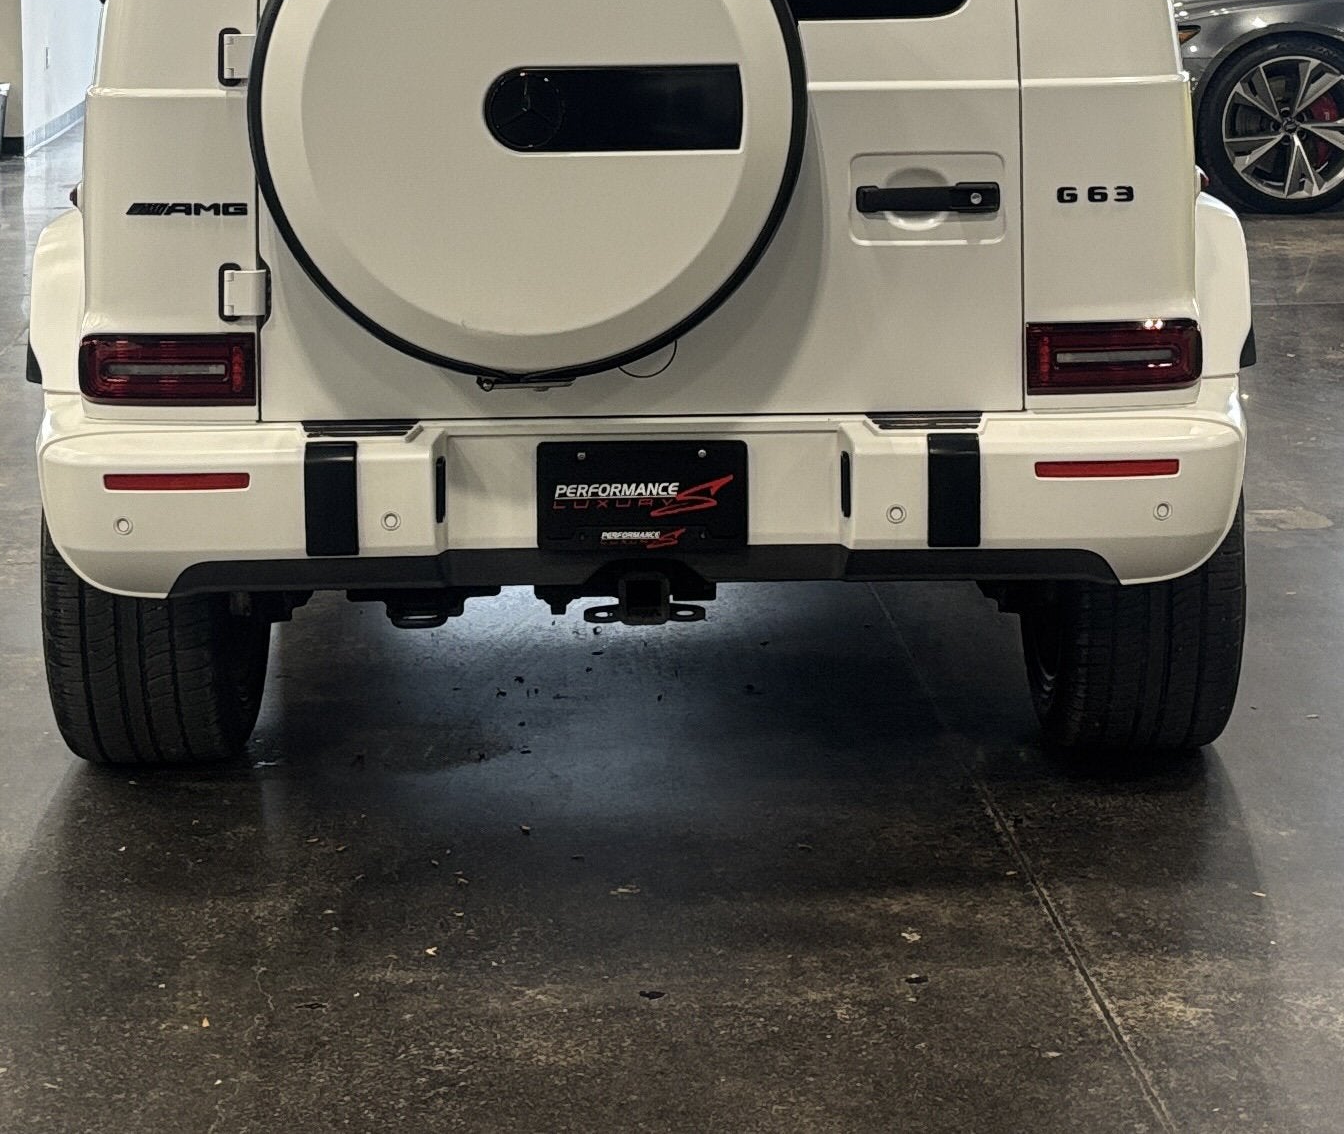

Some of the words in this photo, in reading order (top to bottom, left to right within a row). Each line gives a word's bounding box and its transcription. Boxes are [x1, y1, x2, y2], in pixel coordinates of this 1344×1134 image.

[164, 203, 248, 215] AMG
[555, 482, 680, 498] PERFORMANCE
[553, 498, 674, 509] LUXURY
[601, 531, 661, 539] PERFORMANCE
